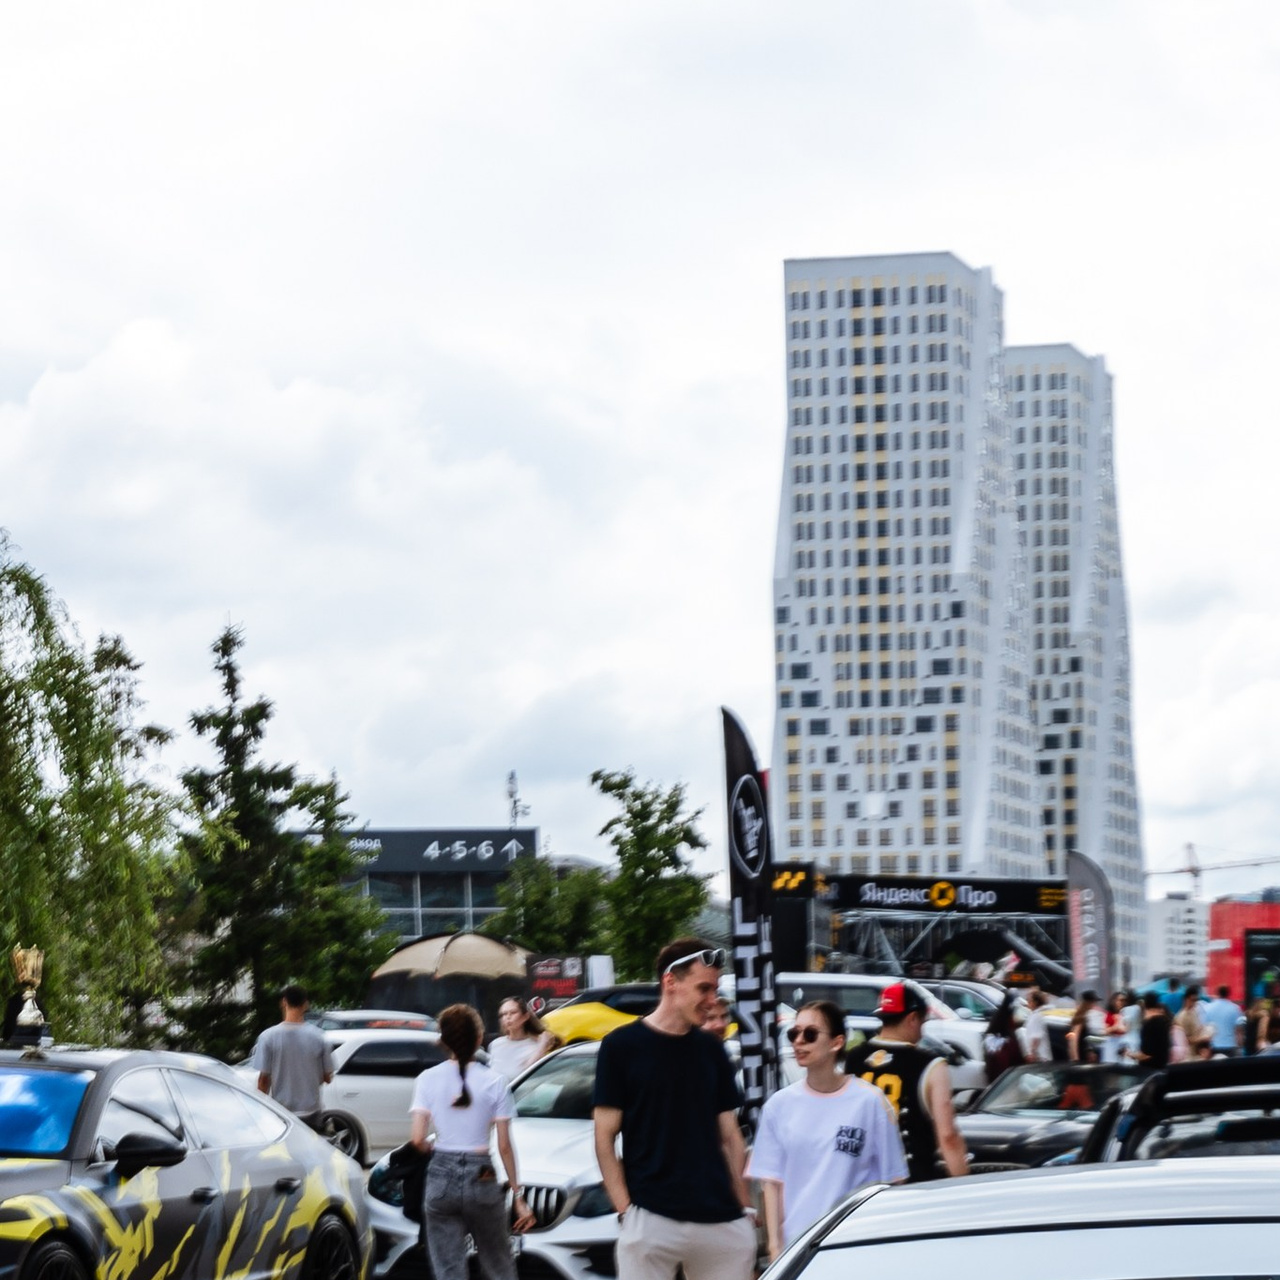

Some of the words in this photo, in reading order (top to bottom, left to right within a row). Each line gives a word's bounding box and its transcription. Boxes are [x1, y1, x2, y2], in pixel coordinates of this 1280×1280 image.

[859, 882, 931, 904] Яндекс
[956, 885, 997, 907] Про
[732, 897, 763, 1121] НИНГ
